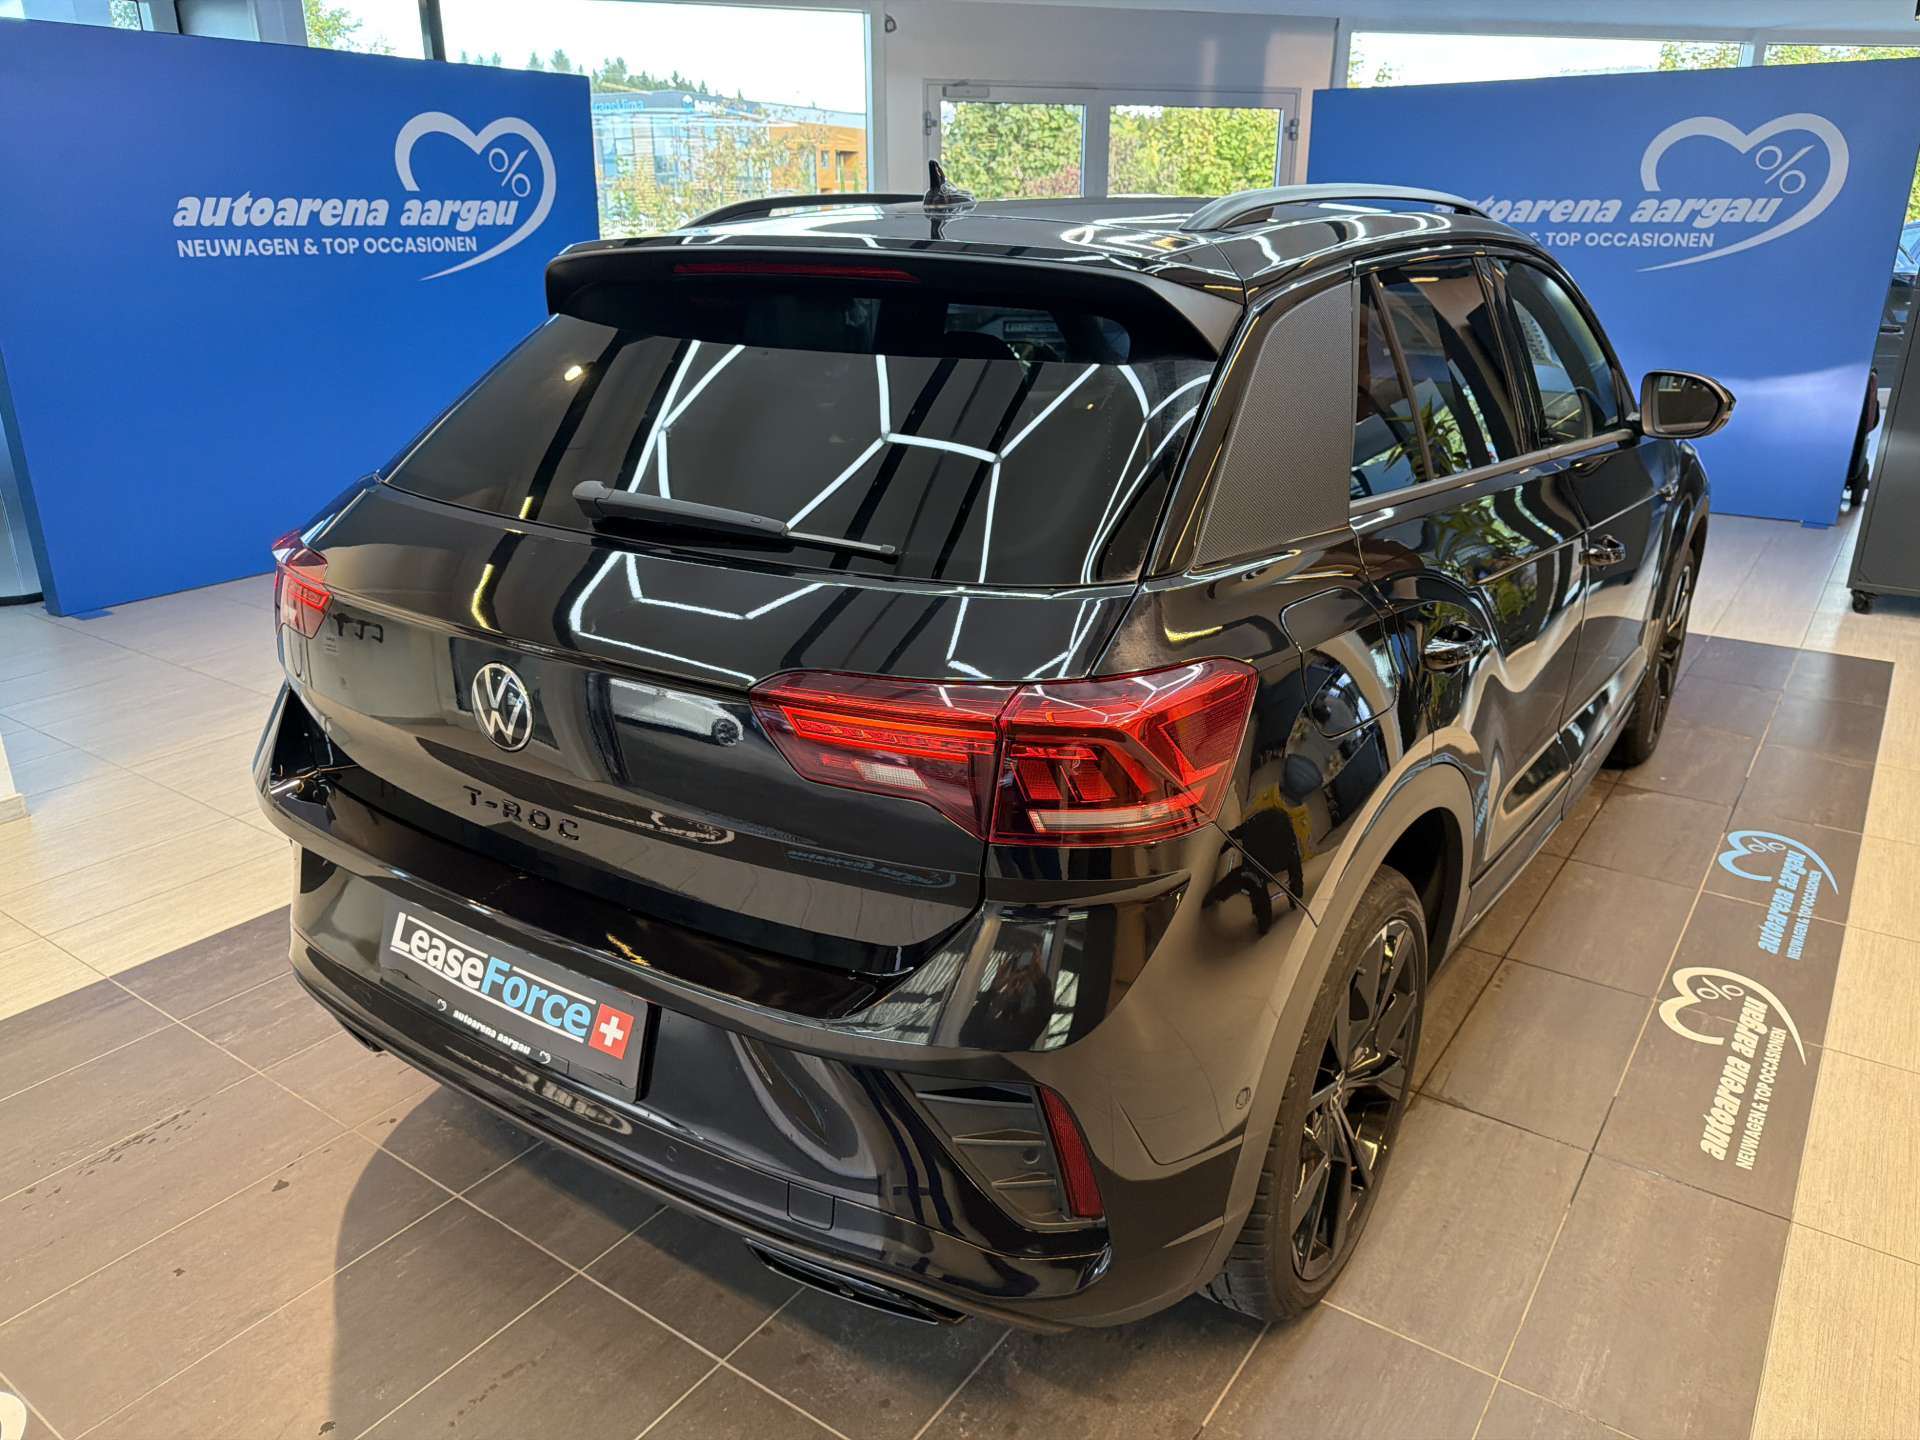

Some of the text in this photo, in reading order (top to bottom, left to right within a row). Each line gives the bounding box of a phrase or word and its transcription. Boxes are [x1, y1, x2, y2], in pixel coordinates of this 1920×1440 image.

[173, 191, 519, 232] autoarena aargau
[1474, 195, 1783, 229] toarena aargau
[177, 236, 478, 258] NEUWAGEN & TOP OCCASIONEN
[1546, 232, 1582, 248] TOP
[1584, 232, 1715, 249] OCCASIONEN
[463, 785, 580, 841] T-ROC
[1758, 888, 1794, 955] autoarena
[390, 912, 592, 1037] LeaseForce
[453, 1010, 531, 1055] autoarena aargau
[1700, 995, 1768, 1161] autoarena aargau
[1736, 1026, 1787, 1171] NEUWAGEN & TOP OCCASIONEN
